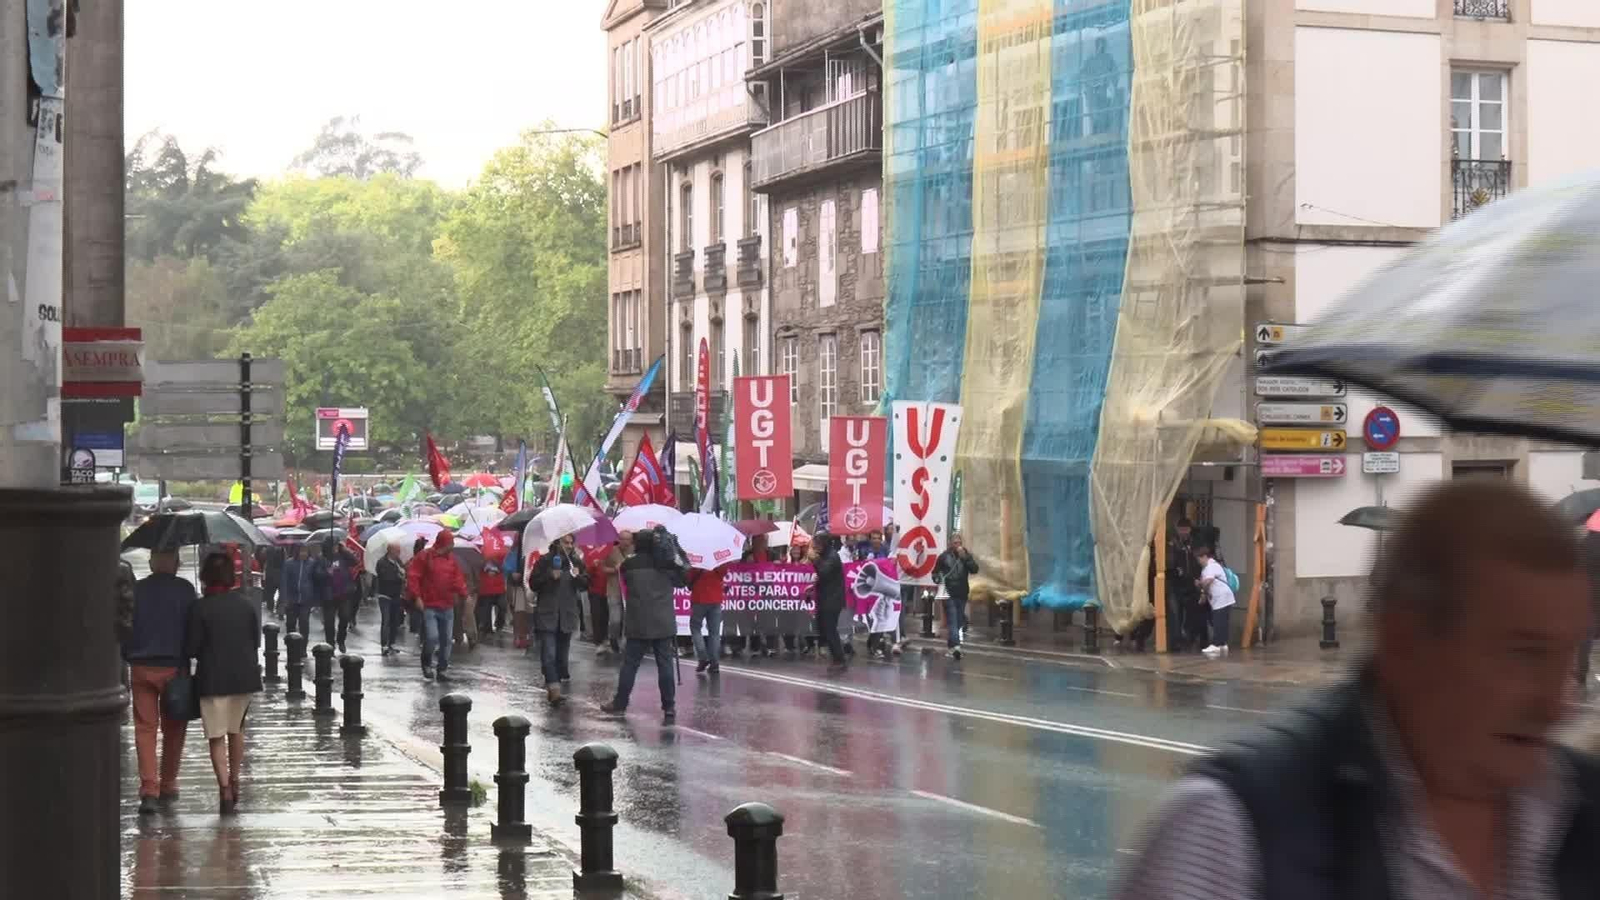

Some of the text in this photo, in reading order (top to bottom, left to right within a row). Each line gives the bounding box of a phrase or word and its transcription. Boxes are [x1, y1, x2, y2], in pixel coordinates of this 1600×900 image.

[750, 379, 775, 468] UGT
[845, 420, 870, 505] UGT
[70, 469, 94, 477] TACO
[896, 407, 946, 580] USO
[722, 569, 819, 584] ÓNS LEXÍTIMA
[723, 585, 756, 597] NTES
[759, 585, 788, 597] PARA
[790, 585, 800, 597] O
[721, 599, 746, 611] SINO
[747, 599, 816, 611] CONCERTAD
